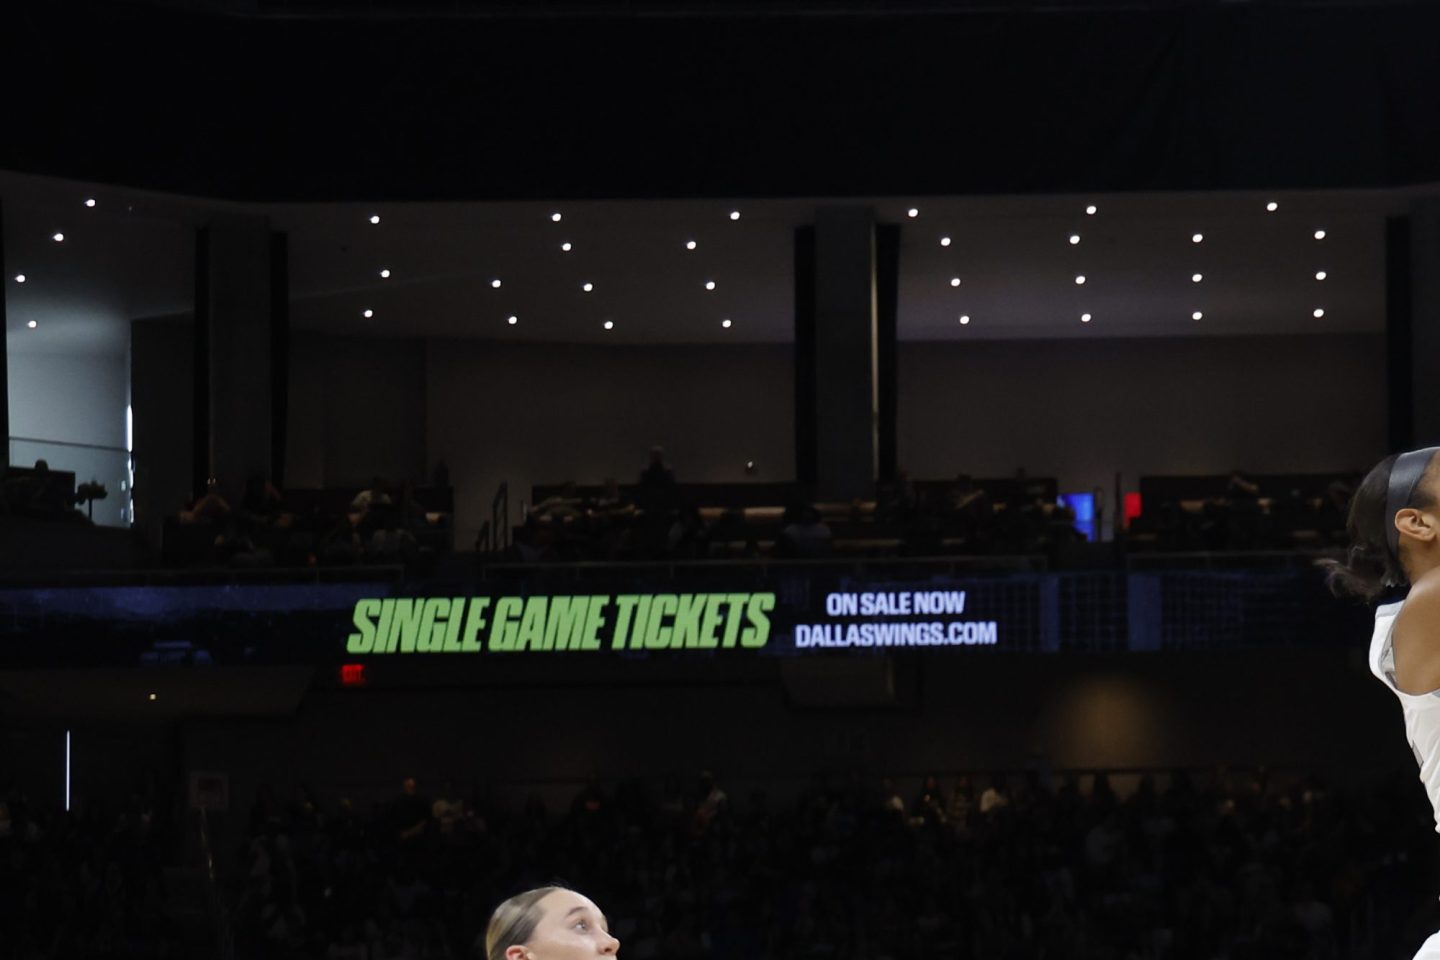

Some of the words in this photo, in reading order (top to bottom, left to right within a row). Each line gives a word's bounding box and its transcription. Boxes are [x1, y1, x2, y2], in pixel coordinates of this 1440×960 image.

[826, 594, 858, 616] ON
[860, 593, 911, 615] SALE
[914, 591, 966, 614] NOW
[346, 597, 490, 654] SINGLE
[488, 595, 610, 651] GAME
[611, 592, 776, 650] TICKETS
[795, 621, 997, 648] DALLASWINGS.COM
